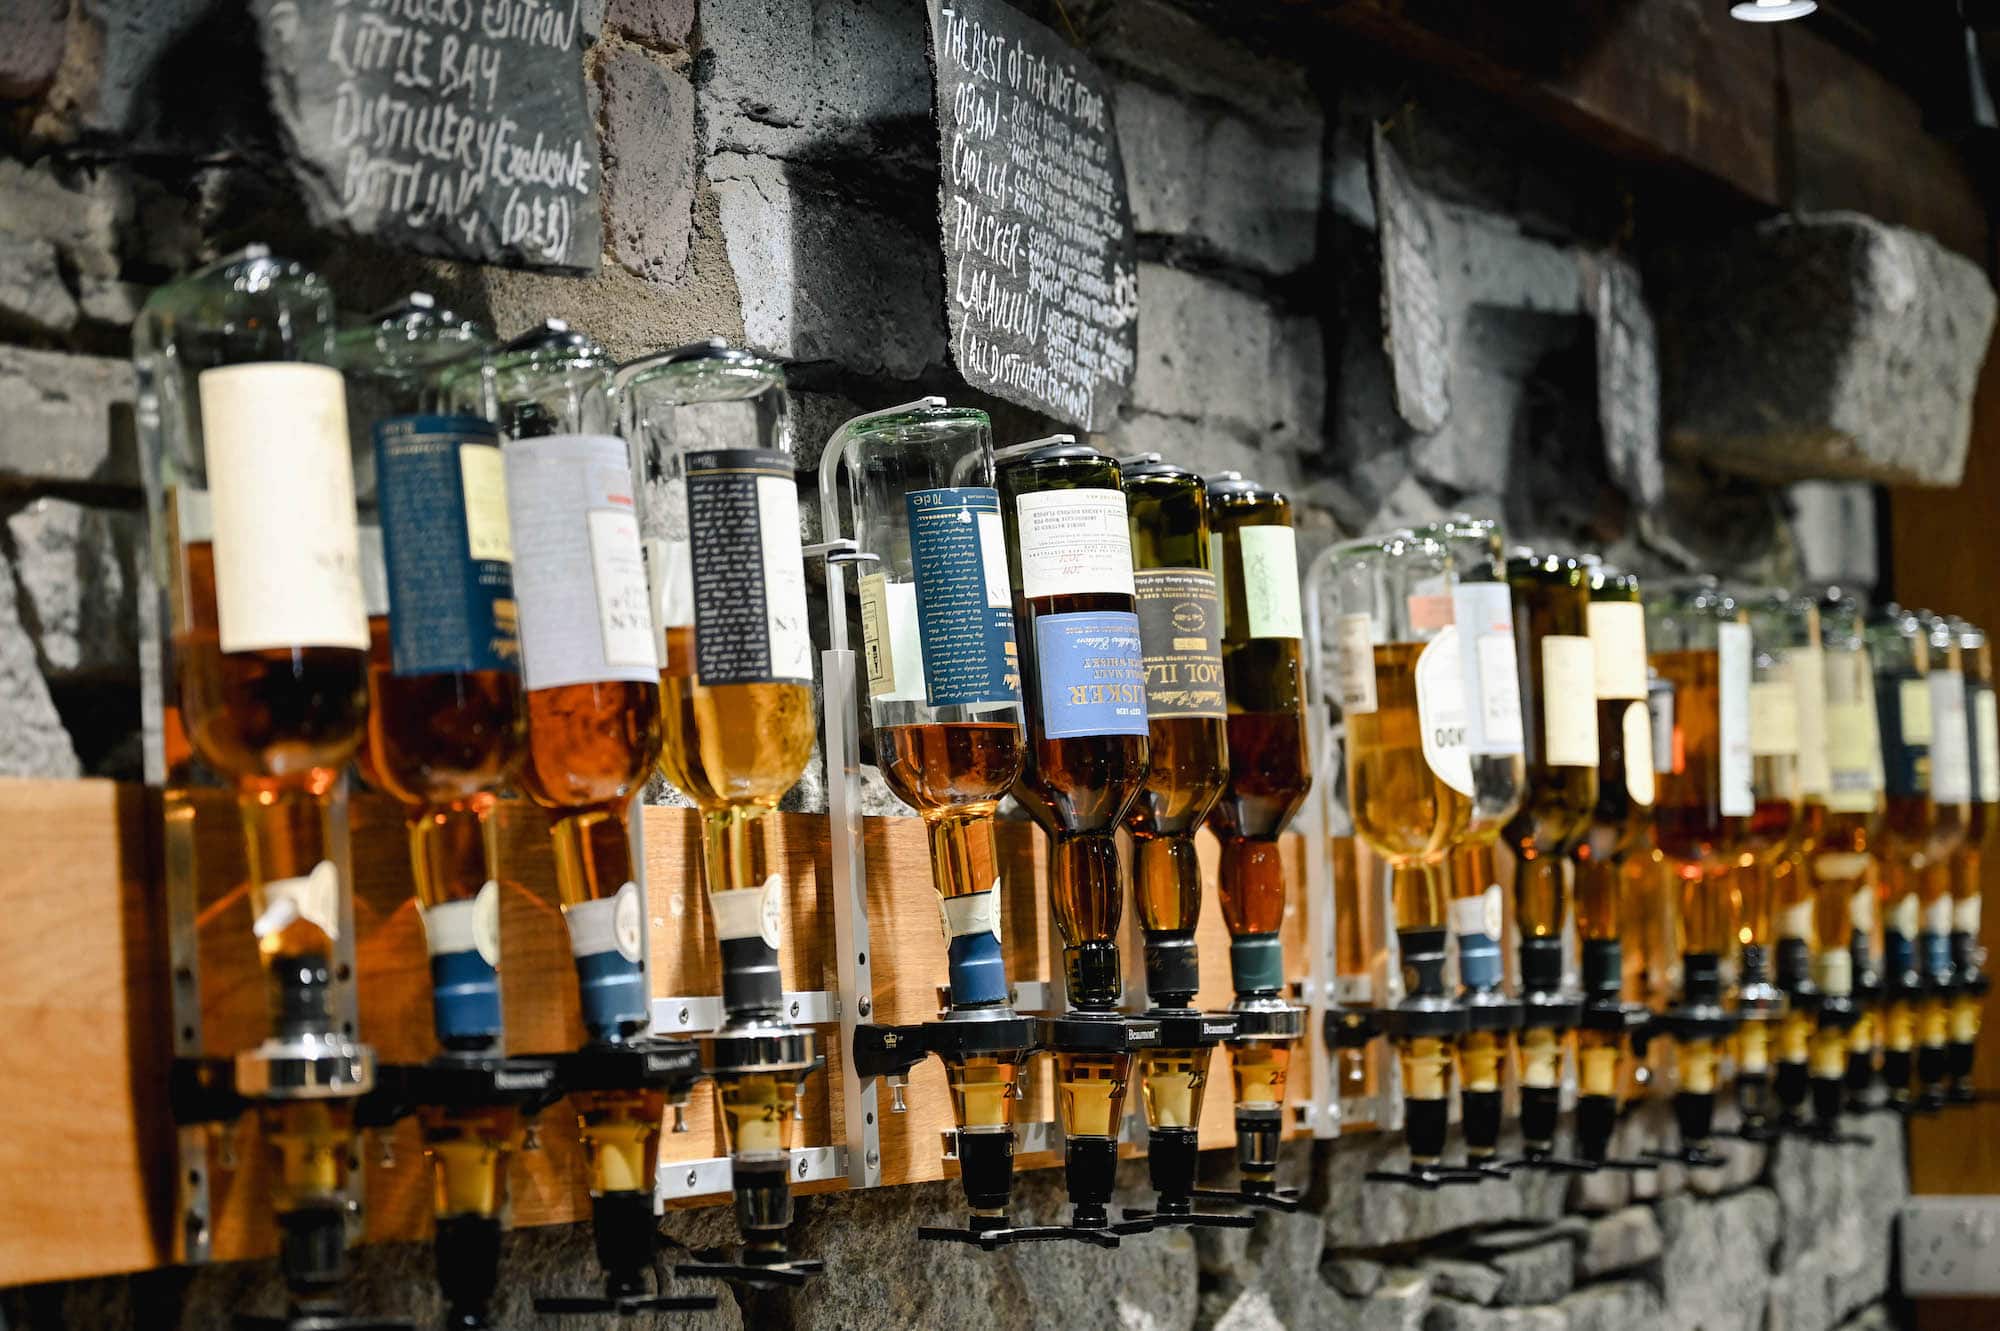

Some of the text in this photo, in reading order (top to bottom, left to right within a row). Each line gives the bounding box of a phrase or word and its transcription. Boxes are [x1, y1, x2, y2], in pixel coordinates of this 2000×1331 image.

[328, 12, 500, 112] LITTLE BAY
[942, 8, 970, 72] THE
[971, 21, 1006, 83] BEST
[953, 81, 1000, 141] OBAN
[951, 132, 983, 194] CAOL
[985, 161, 1007, 210] ILA
[954, 195, 1021, 278] TALISKER
[956, 252, 1045, 345] LAGAVULIN
[932, 493, 943, 505] 70
